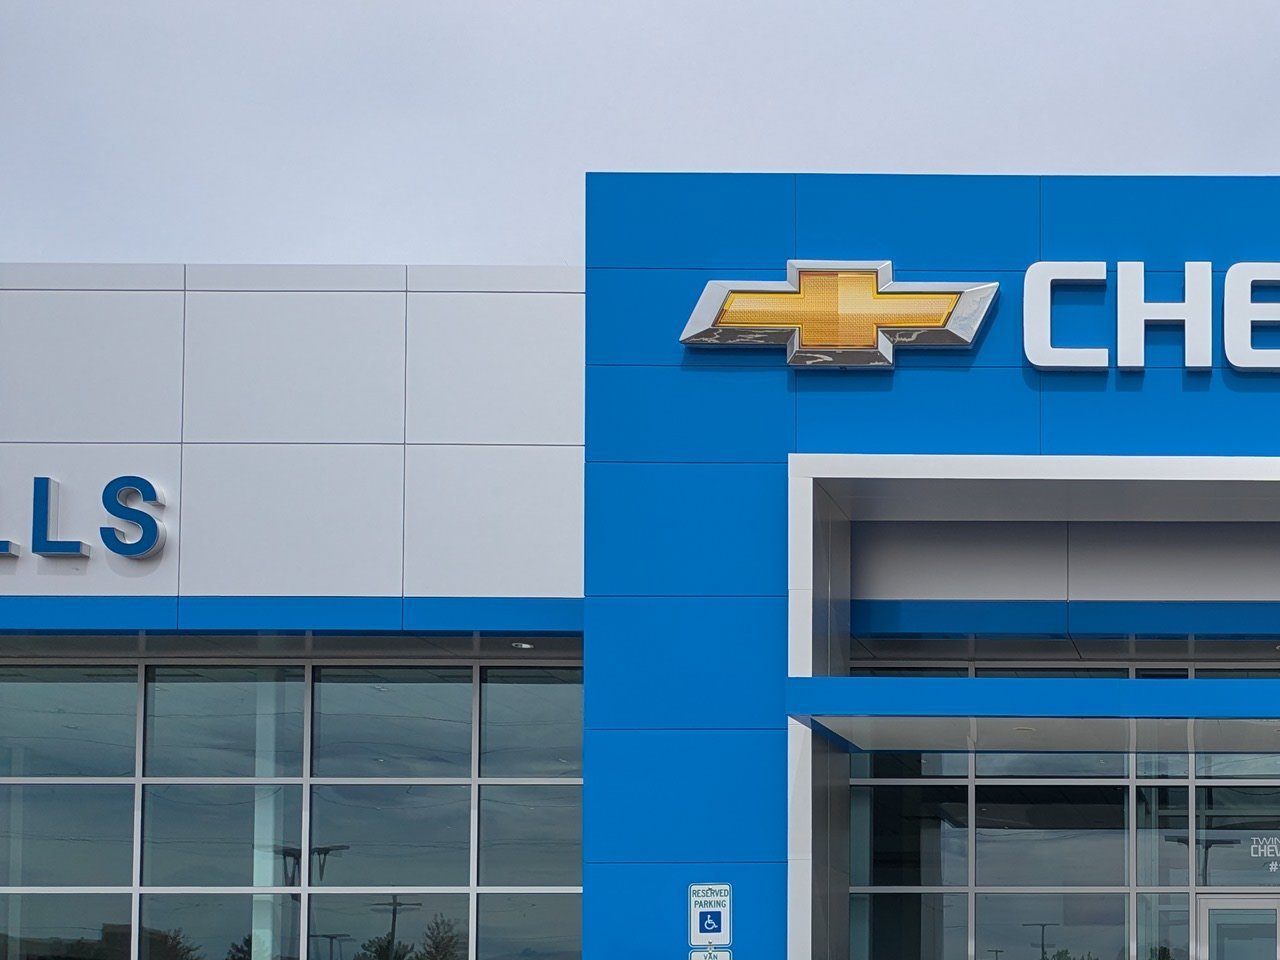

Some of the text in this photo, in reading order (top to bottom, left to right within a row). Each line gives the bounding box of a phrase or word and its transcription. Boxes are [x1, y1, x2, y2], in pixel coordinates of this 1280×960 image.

[0, 475, 164, 559] LS
[692, 888, 729, 898] RESERVED
[694, 900, 727, 909] PARKING
